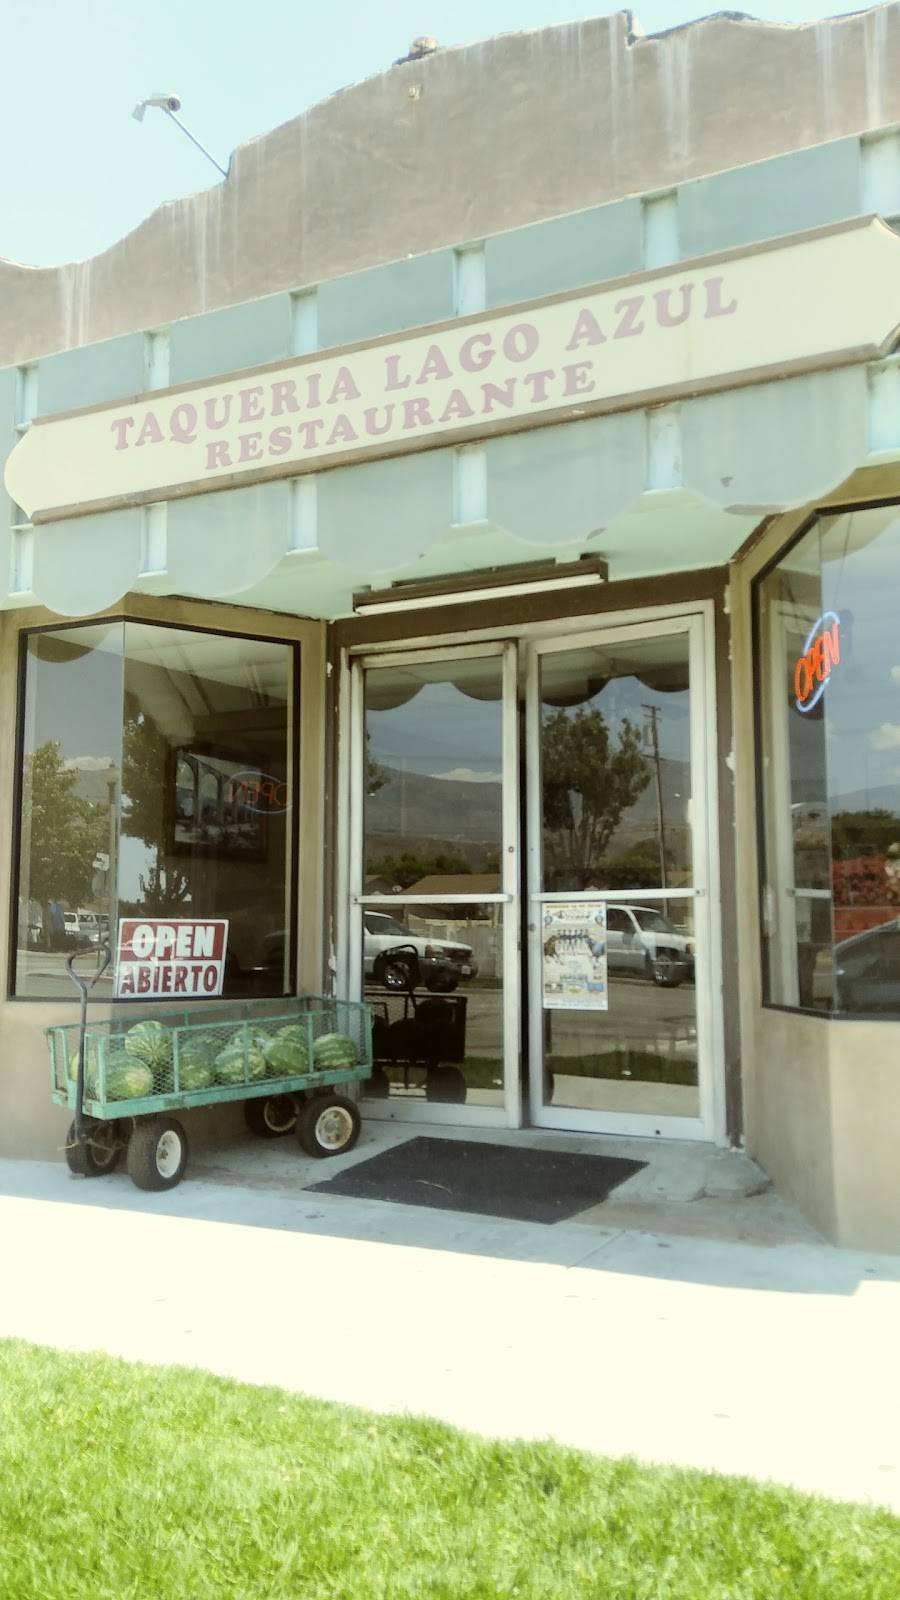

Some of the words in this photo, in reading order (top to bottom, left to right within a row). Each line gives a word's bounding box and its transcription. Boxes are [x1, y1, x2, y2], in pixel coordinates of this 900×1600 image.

[110, 366, 362, 450] TAQUERIA
[384, 323, 540, 392] LAGO
[565, 277, 739, 351] AZUL
[205, 360, 597, 470] RESTAURANTE
[794, 623, 840, 702] OPEN
[120, 964, 218, 994] ABIERTO
[131, 924, 216, 958] OPEN
